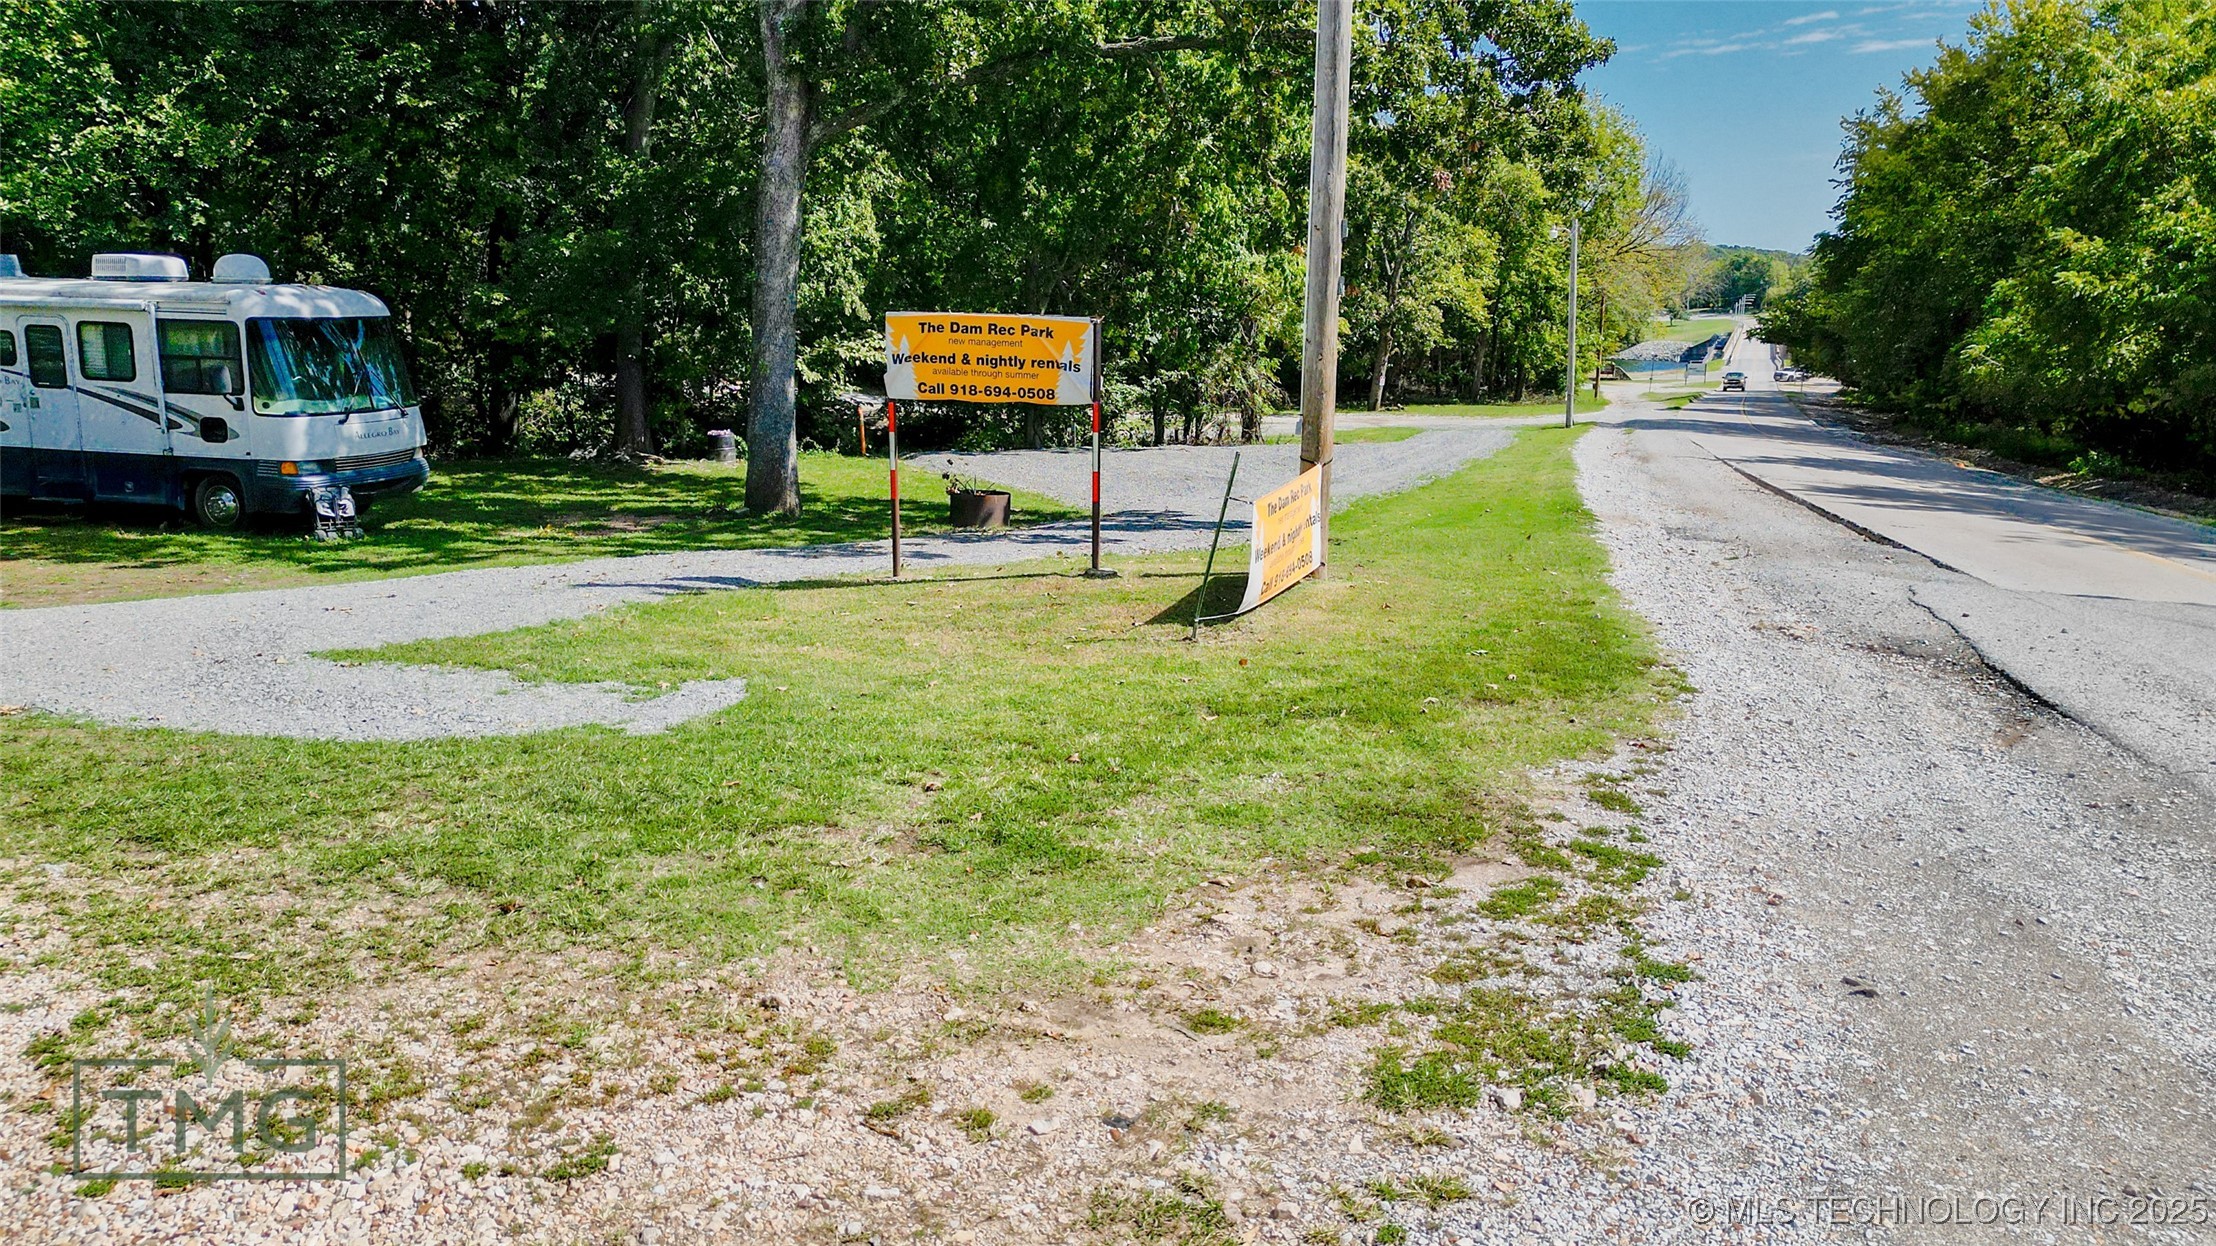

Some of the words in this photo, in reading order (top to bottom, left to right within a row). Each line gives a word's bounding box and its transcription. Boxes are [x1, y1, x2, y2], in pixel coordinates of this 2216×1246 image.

[918, 322, 945, 334] The
[950, 322, 983, 336] Dam
[988, 323, 1015, 336] Rec
[1020, 324, 1054, 339] Park
[948, 337, 966, 346] new
[968, 338, 1023, 348] management
[892, 352, 956, 365] Weekend
[961, 353, 971, 366] &
[976, 354, 1026, 370] nightly
[1031, 357, 1081, 373] rentals
[932, 367, 969, 377] available
[970, 368, 1003, 379] through
[1005, 371, 1040, 380] summer
[917, 382, 945, 396] Call
[950, 384, 1056, 400] 918-694-0508
[1267, 502, 1277, 518] The
[1254, 535, 1281, 564] Weekend
